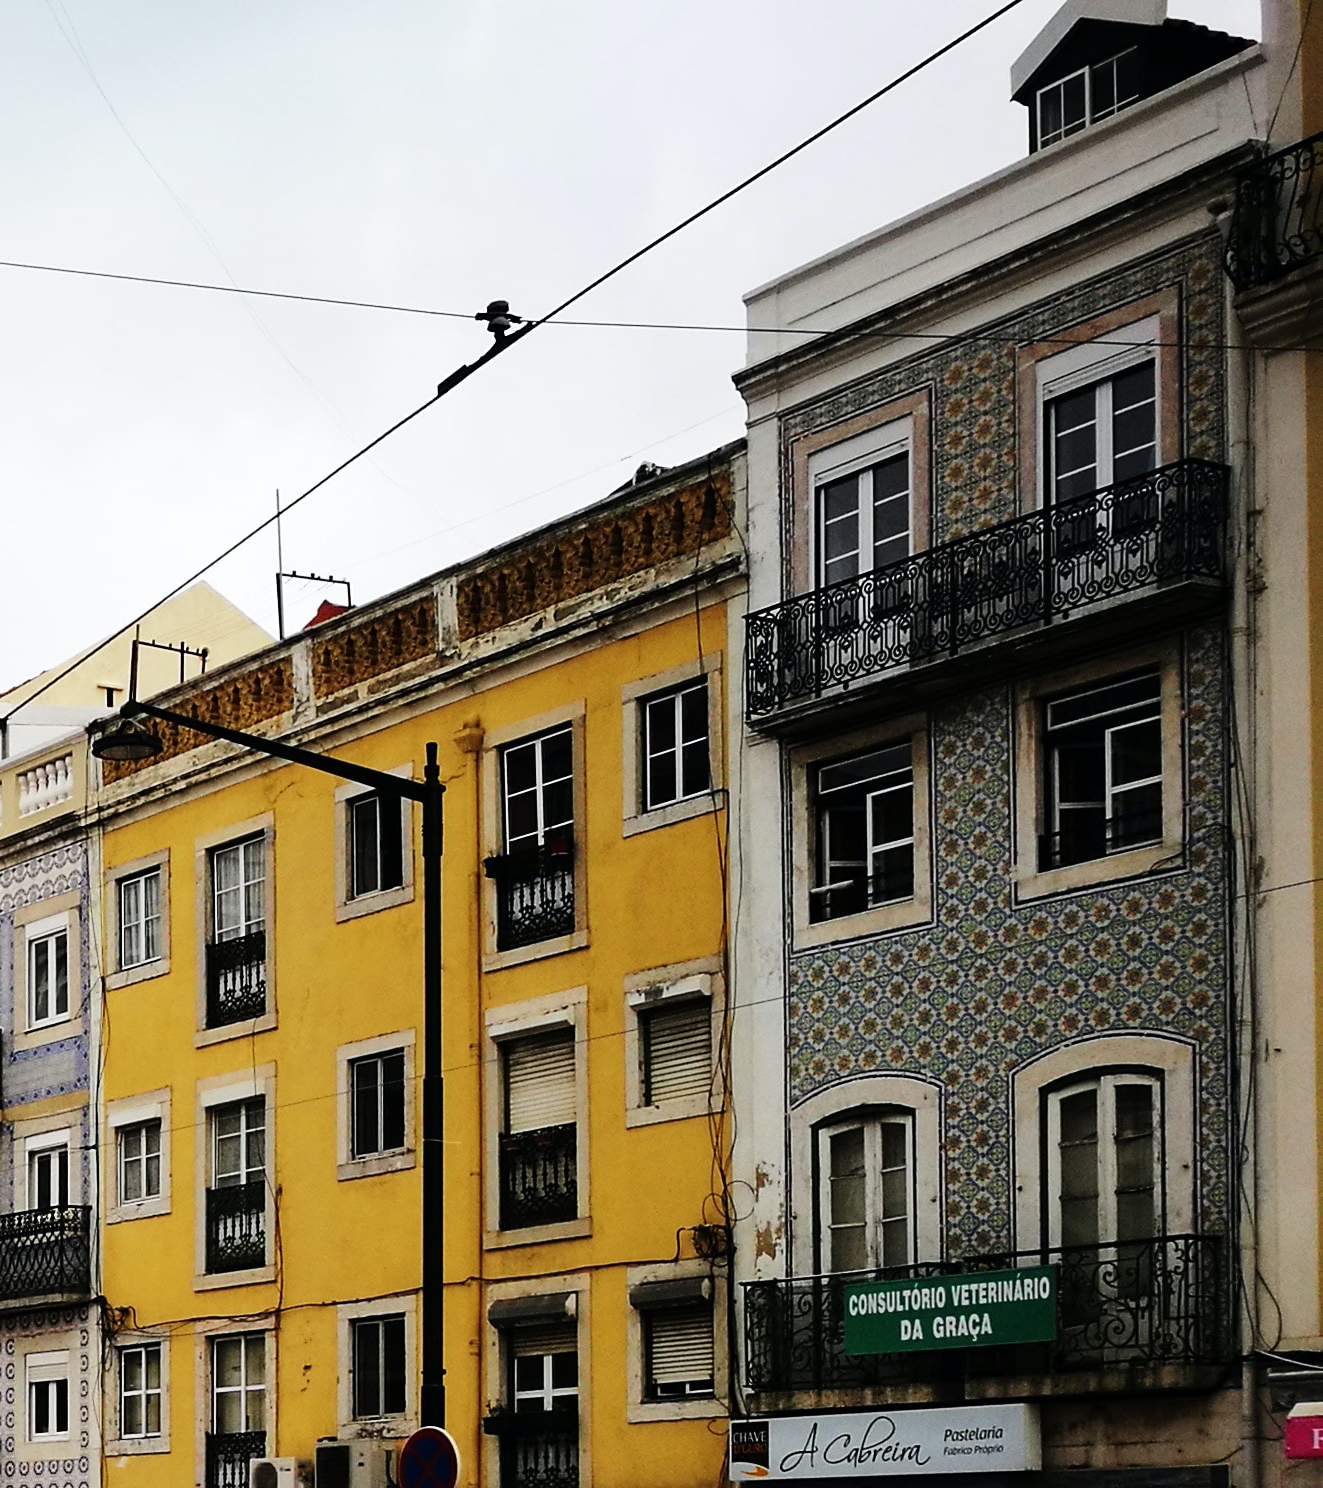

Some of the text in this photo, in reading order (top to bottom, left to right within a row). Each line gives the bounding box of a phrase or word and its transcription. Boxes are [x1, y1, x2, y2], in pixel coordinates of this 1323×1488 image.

[848, 1273, 1051, 1317] CONSULTÓRIO VETERINÁRIO
[900, 1313, 993, 1342] DA GRAÇA
[733, 1430, 767, 1443] CHAVE
[779, 1416, 931, 1472] A Cabreira
[943, 1425, 1003, 1442] Pastelaria
[943, 1446, 973, 1456] Fabrico
